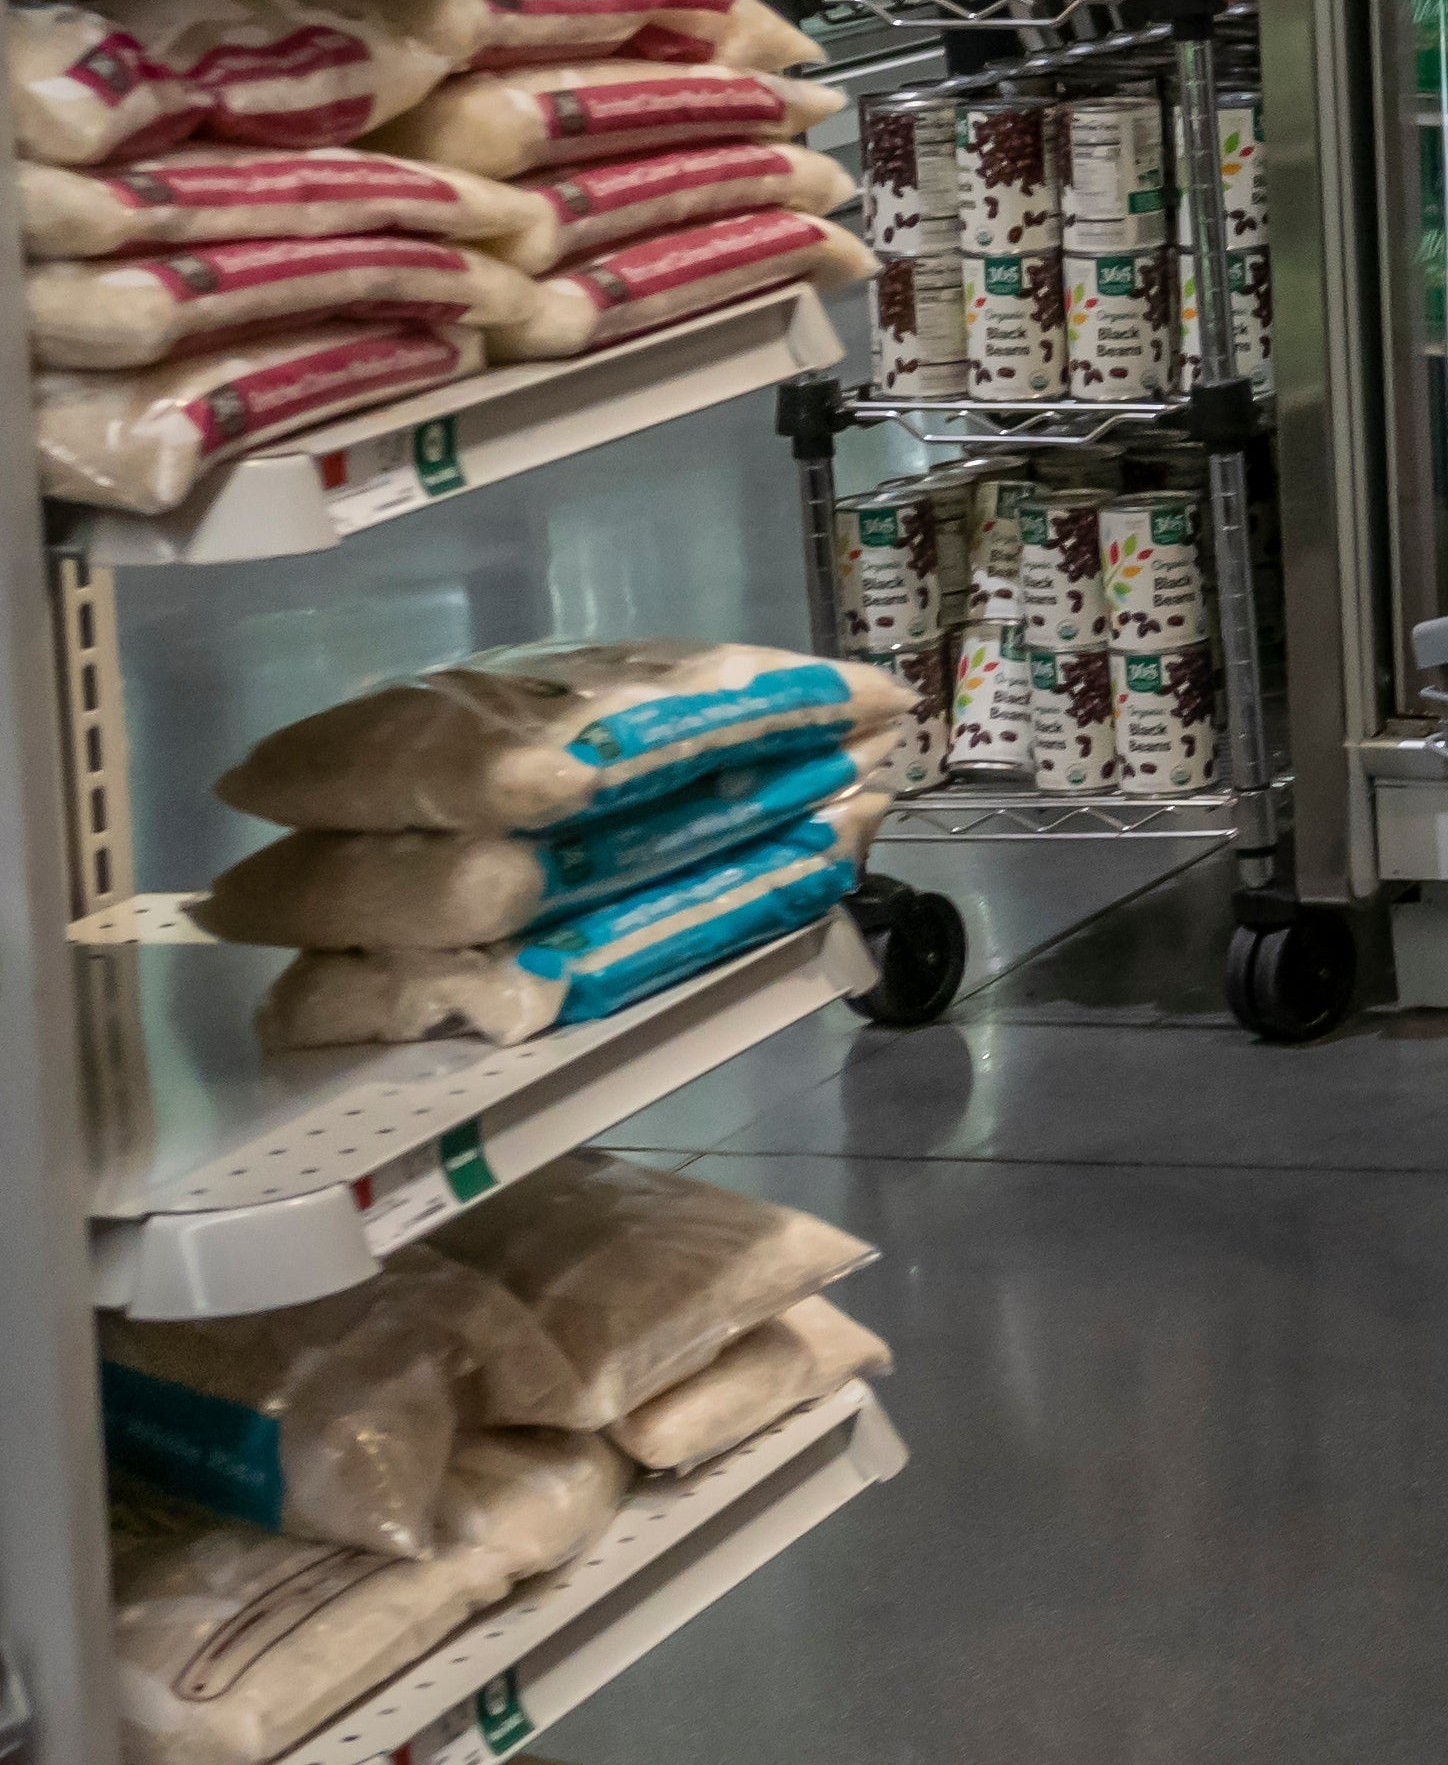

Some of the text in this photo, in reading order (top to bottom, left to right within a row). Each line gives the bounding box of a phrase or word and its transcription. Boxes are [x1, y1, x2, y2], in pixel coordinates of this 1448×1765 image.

[986, 326, 1027, 340] Black
[1097, 326, 1140, 340] Black
[985, 342, 1031, 357] Beans
[1097, 343, 1143, 357] Beans
[862, 575, 904, 590] Black
[1153, 575, 1193, 590] Black
[862, 592, 909, 607] Beans
[1128, 721, 1170, 736] Black
